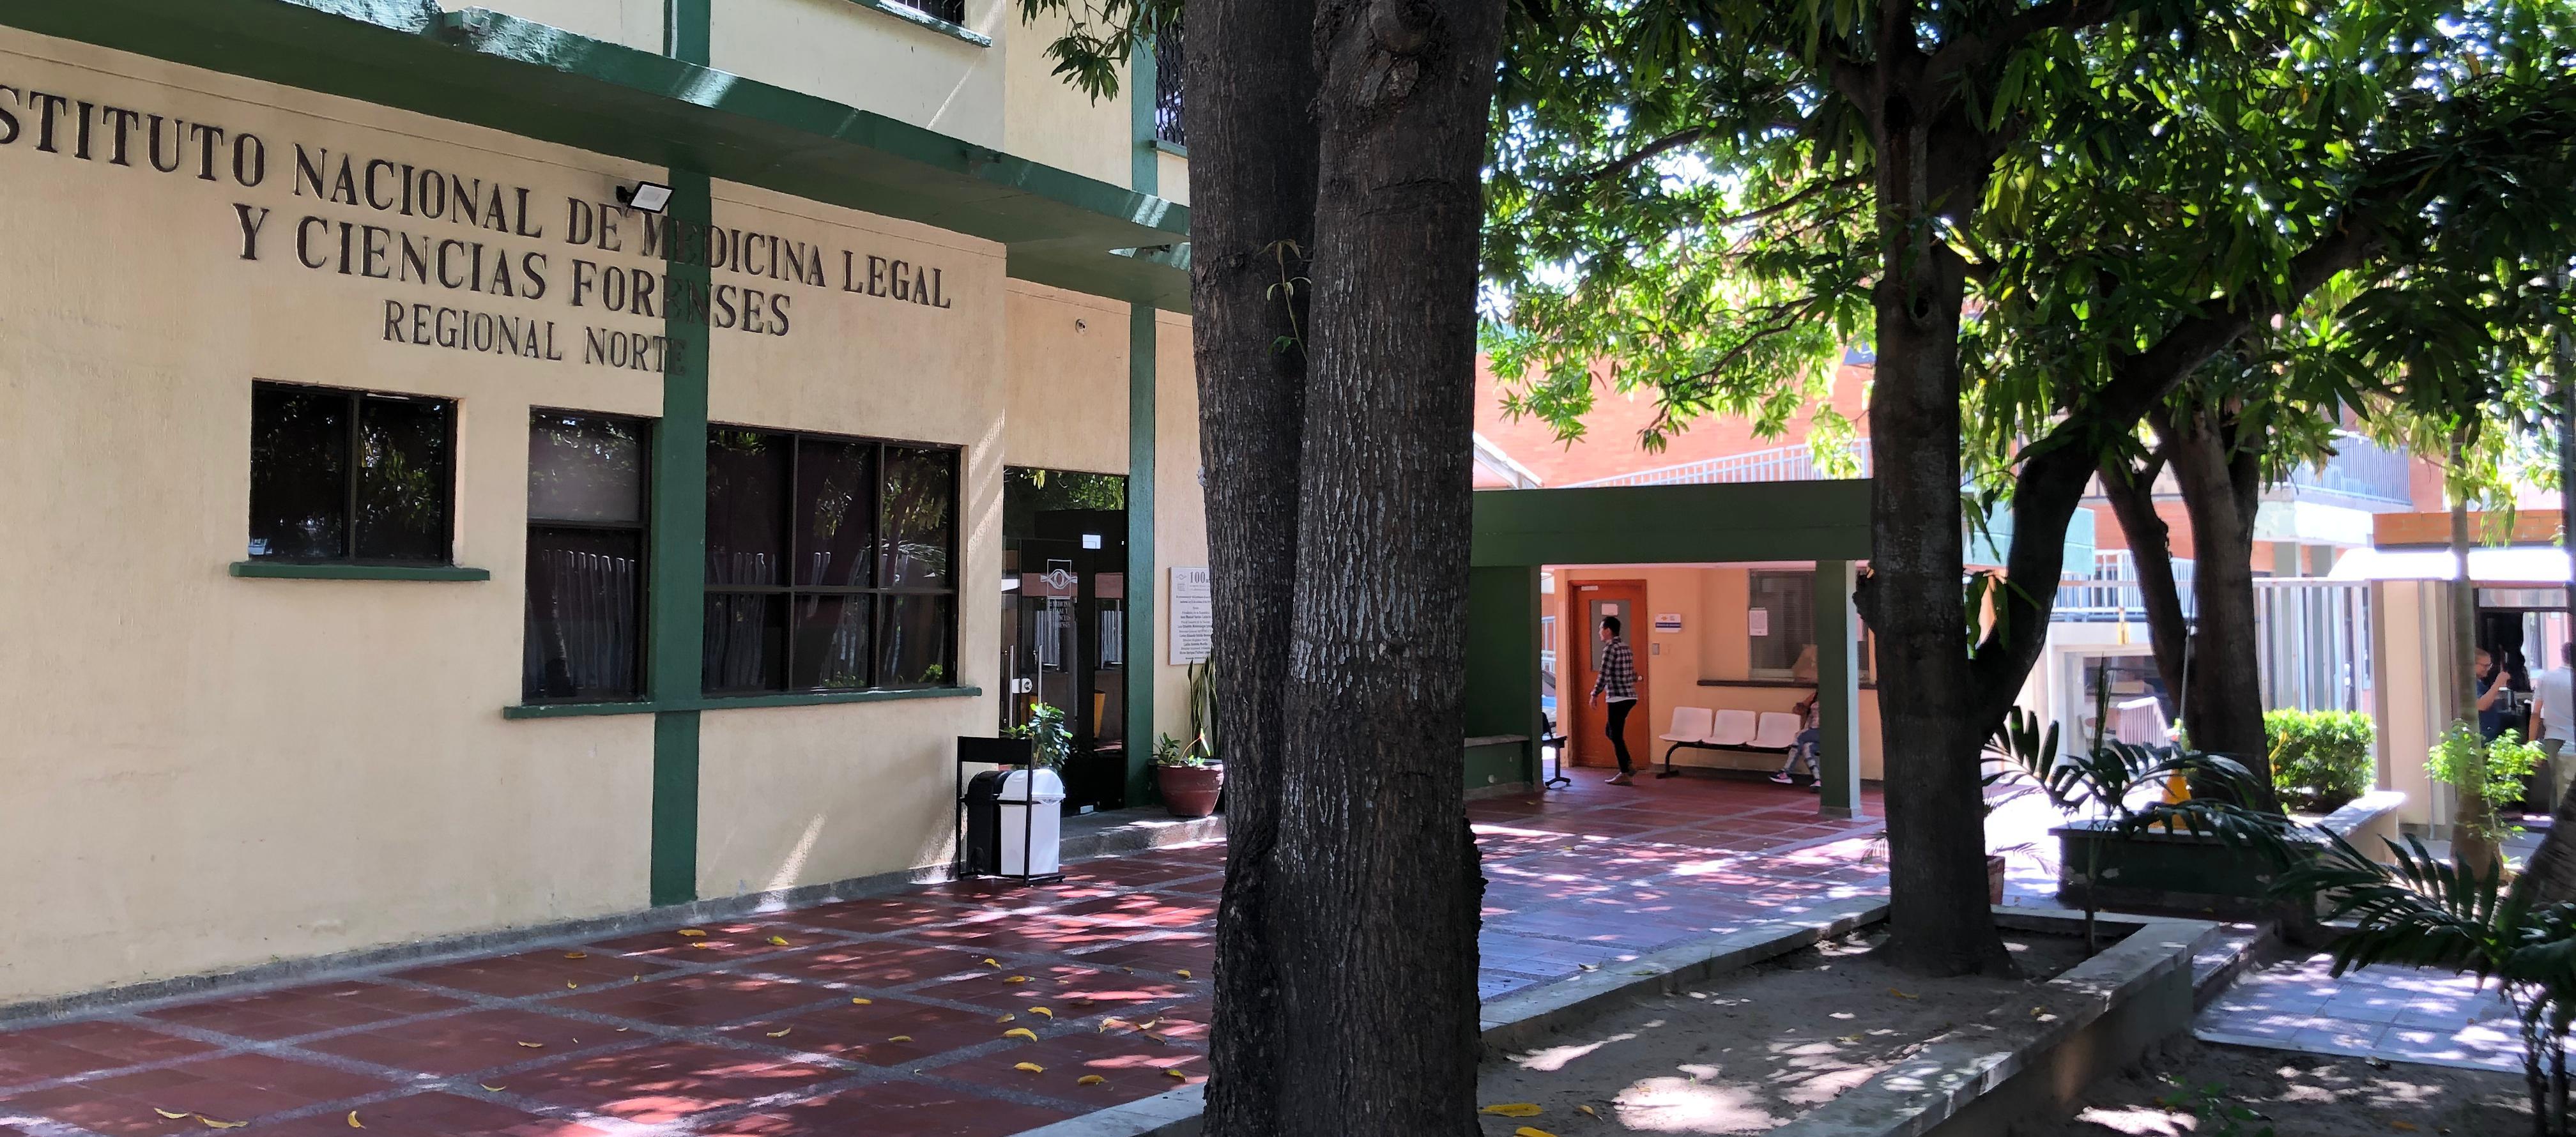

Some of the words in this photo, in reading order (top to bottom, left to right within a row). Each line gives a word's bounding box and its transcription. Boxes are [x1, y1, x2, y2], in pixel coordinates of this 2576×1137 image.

[0, 84, 265, 187] STITUTO
[293, 143, 542, 239] NACIONAL
[565, 196, 622, 252] DE
[641, 210, 825, 287] MEDICINA
[841, 249, 951, 309] LEGAL
[232, 202, 269, 260] Y
[295, 215, 547, 300] CIENCIAS
[571, 259, 790, 336] FORENSES
[383, 300, 562, 360] REGIONAL
[585, 326, 686, 376] NORTE
[1190, 571, 1206, 584] 100
